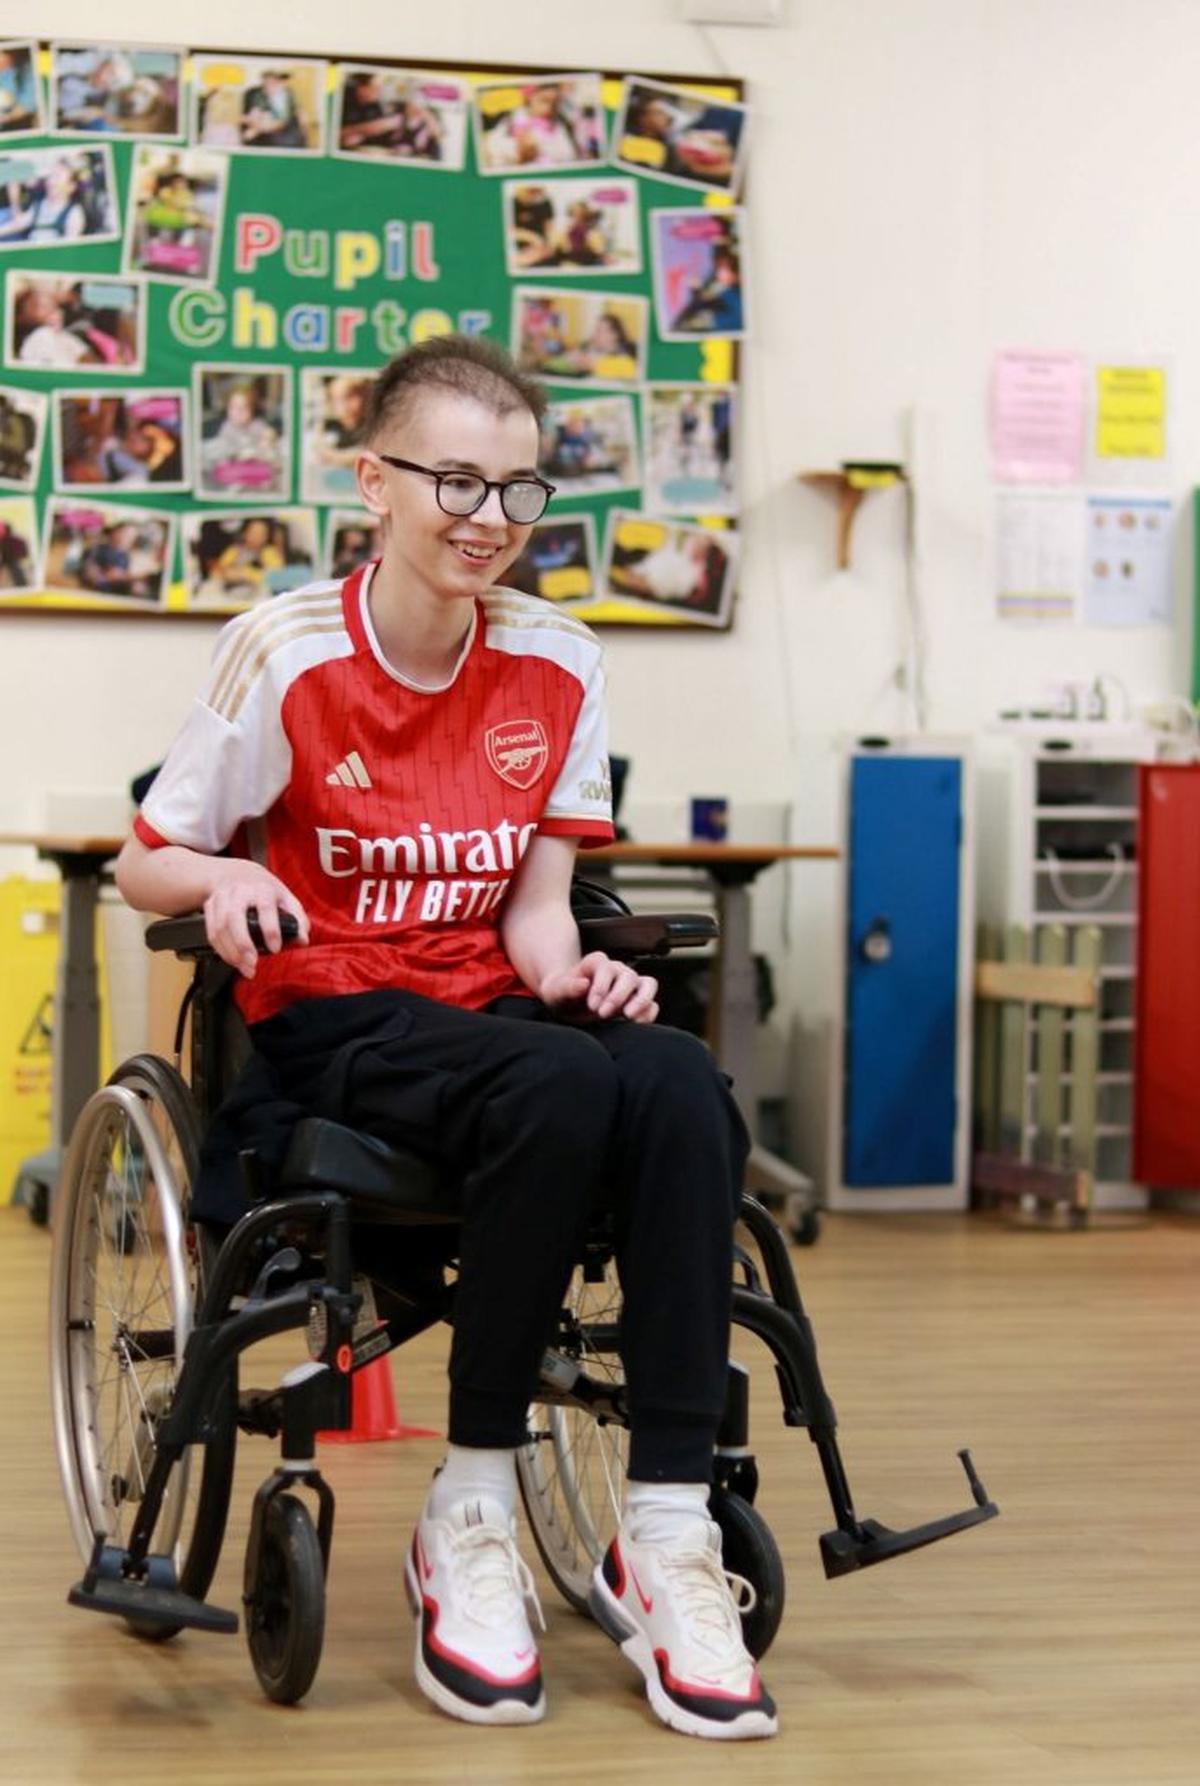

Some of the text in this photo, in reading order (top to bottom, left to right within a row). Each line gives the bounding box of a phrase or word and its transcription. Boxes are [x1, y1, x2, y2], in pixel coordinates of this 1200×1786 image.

[234, 212, 440, 290] Pupil
[168, 286, 492, 354] Charter
[494, 730, 540, 747] Arsenal
[355, 879, 413, 923] FLY
